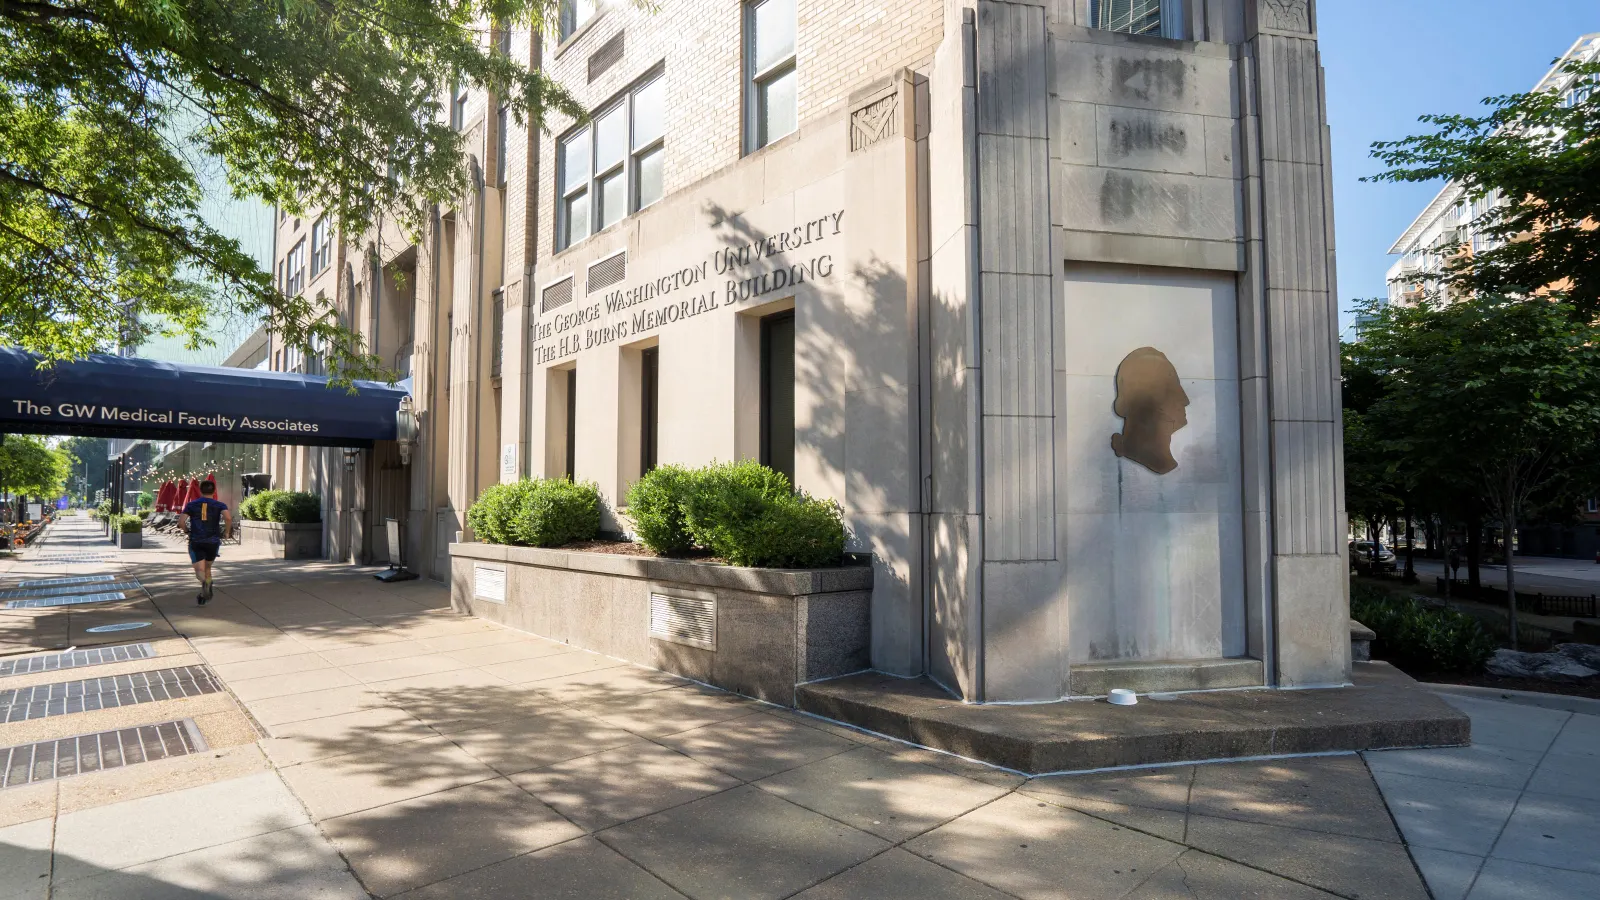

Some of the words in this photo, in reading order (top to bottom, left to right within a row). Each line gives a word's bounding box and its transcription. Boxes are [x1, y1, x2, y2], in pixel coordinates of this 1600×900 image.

[534, 345, 556, 365] THE
[585, 320, 628, 350] BURNS
[631, 290, 719, 336] MEMORIAL
[724, 254, 834, 307] BUILDING
[554, 302, 600, 334] GEORGE
[605, 260, 707, 315] WASHINGTON
[714, 209, 845, 276] UNIVERSITY
[12, 399, 52, 416] The
[57, 403, 96, 419] GW
[101, 406, 173, 424] Medical
[178, 411, 237, 431] Faculty
[239, 416, 319, 433] Associates
